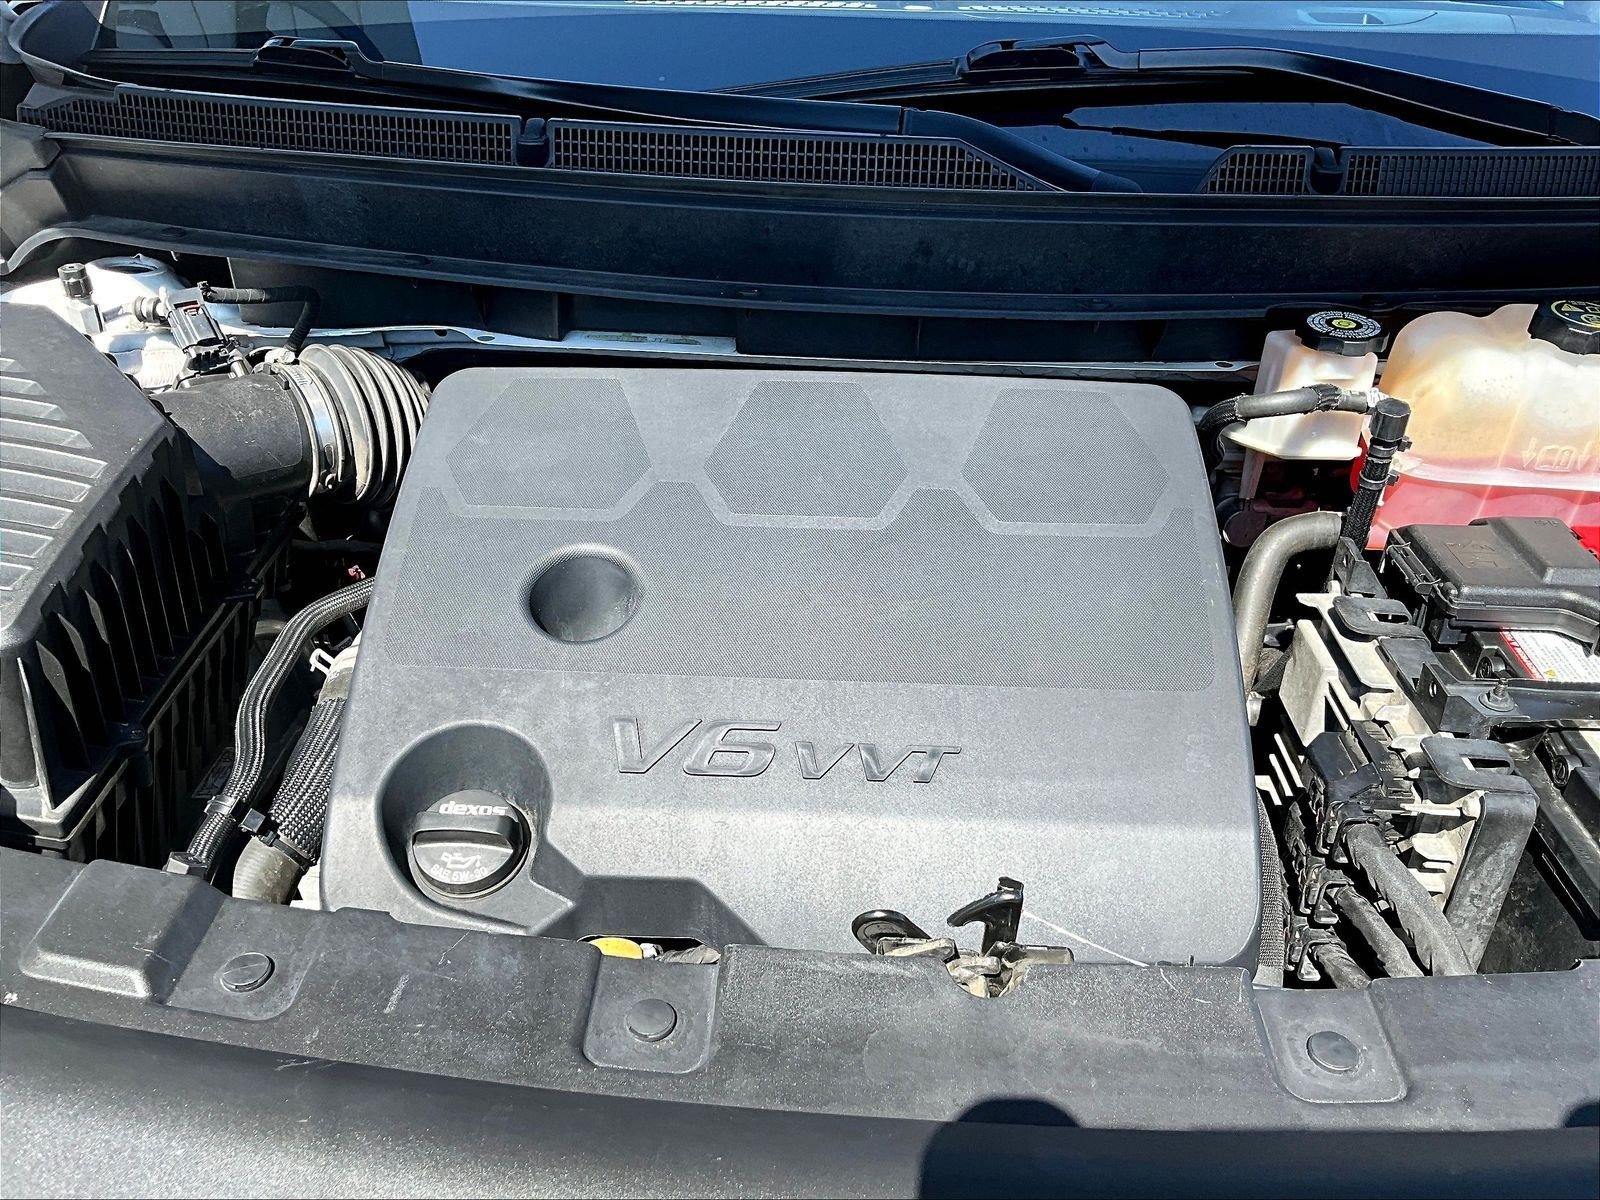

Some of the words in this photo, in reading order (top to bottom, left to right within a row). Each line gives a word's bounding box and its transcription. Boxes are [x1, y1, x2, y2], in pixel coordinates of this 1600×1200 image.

[613, 717, 782, 777] V6
[795, 741, 962, 783] VVT
[439, 801, 508, 816] dexos
[452, 866, 488, 881] 5W-30
